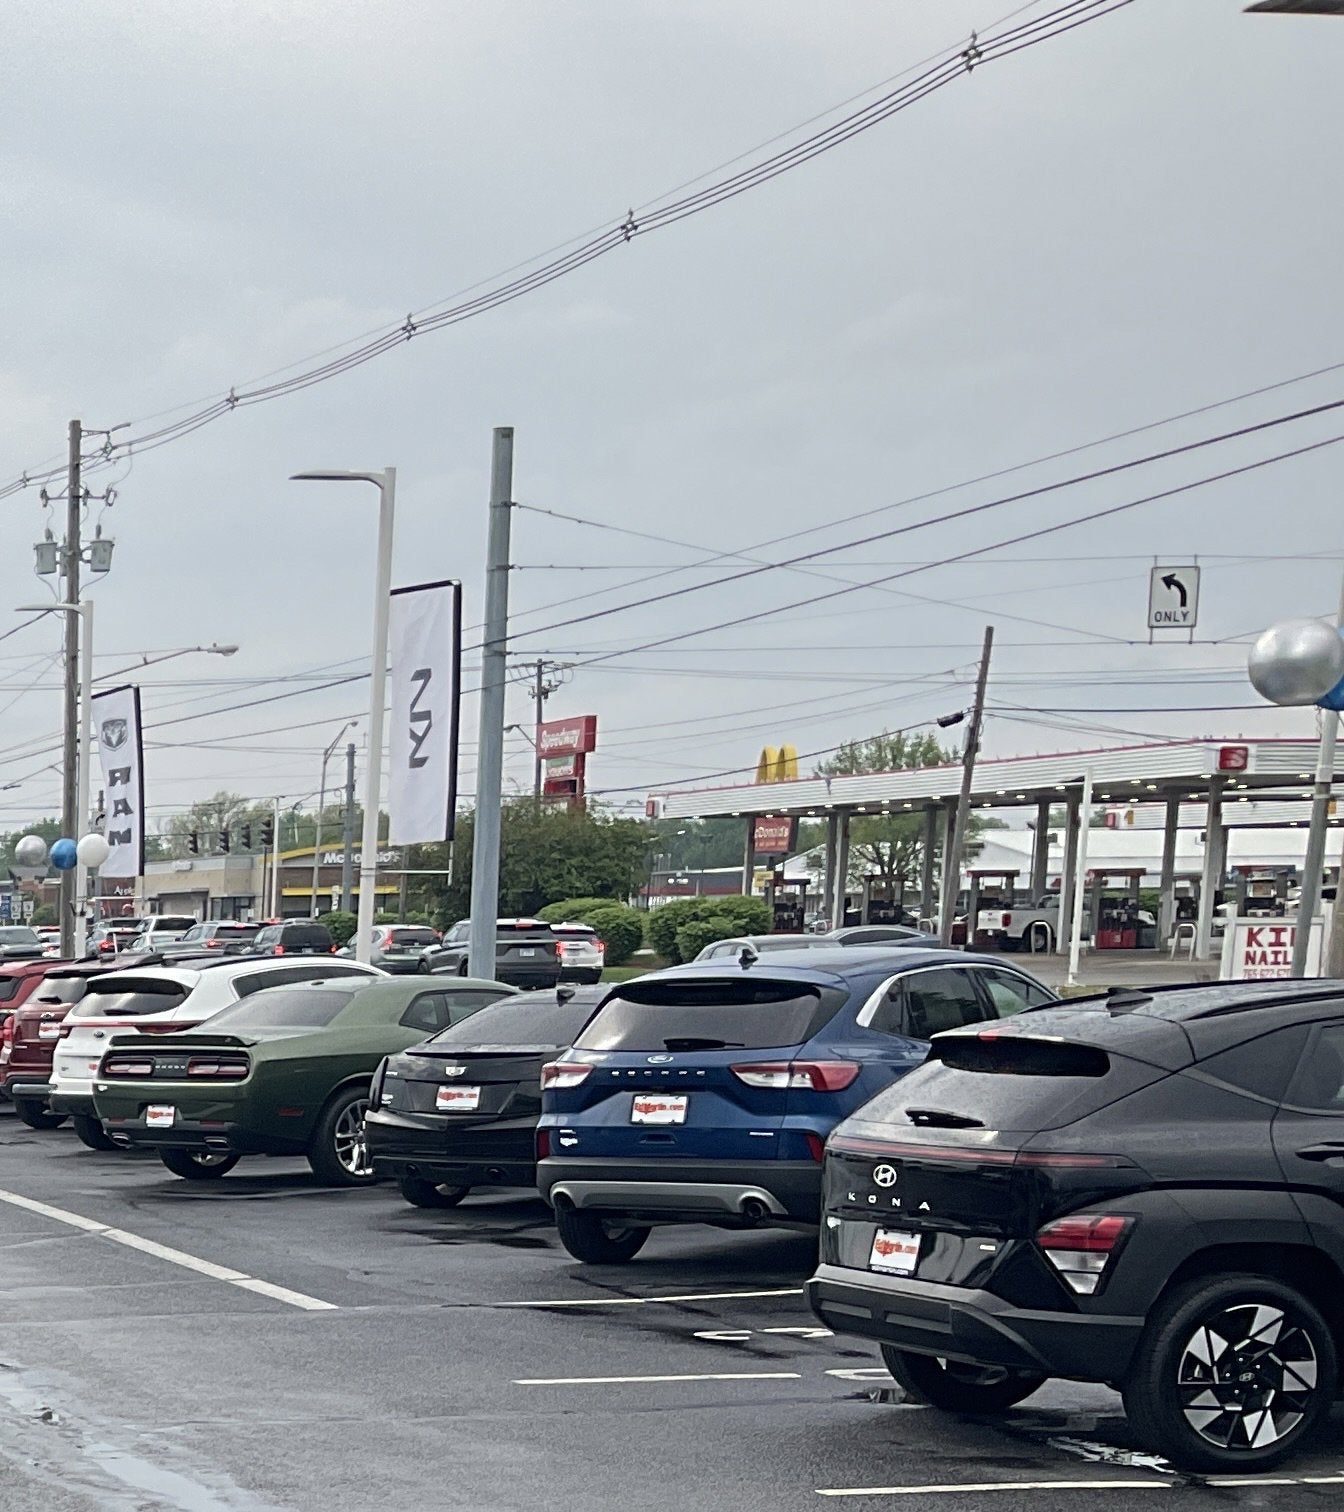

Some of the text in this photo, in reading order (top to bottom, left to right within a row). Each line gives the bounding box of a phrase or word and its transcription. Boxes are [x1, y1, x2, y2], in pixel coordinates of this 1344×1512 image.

[1154, 610, 1190, 623] ONLY
[1244, 950, 1292, 966] NAIL
[848, 1191, 931, 1211] KONA
